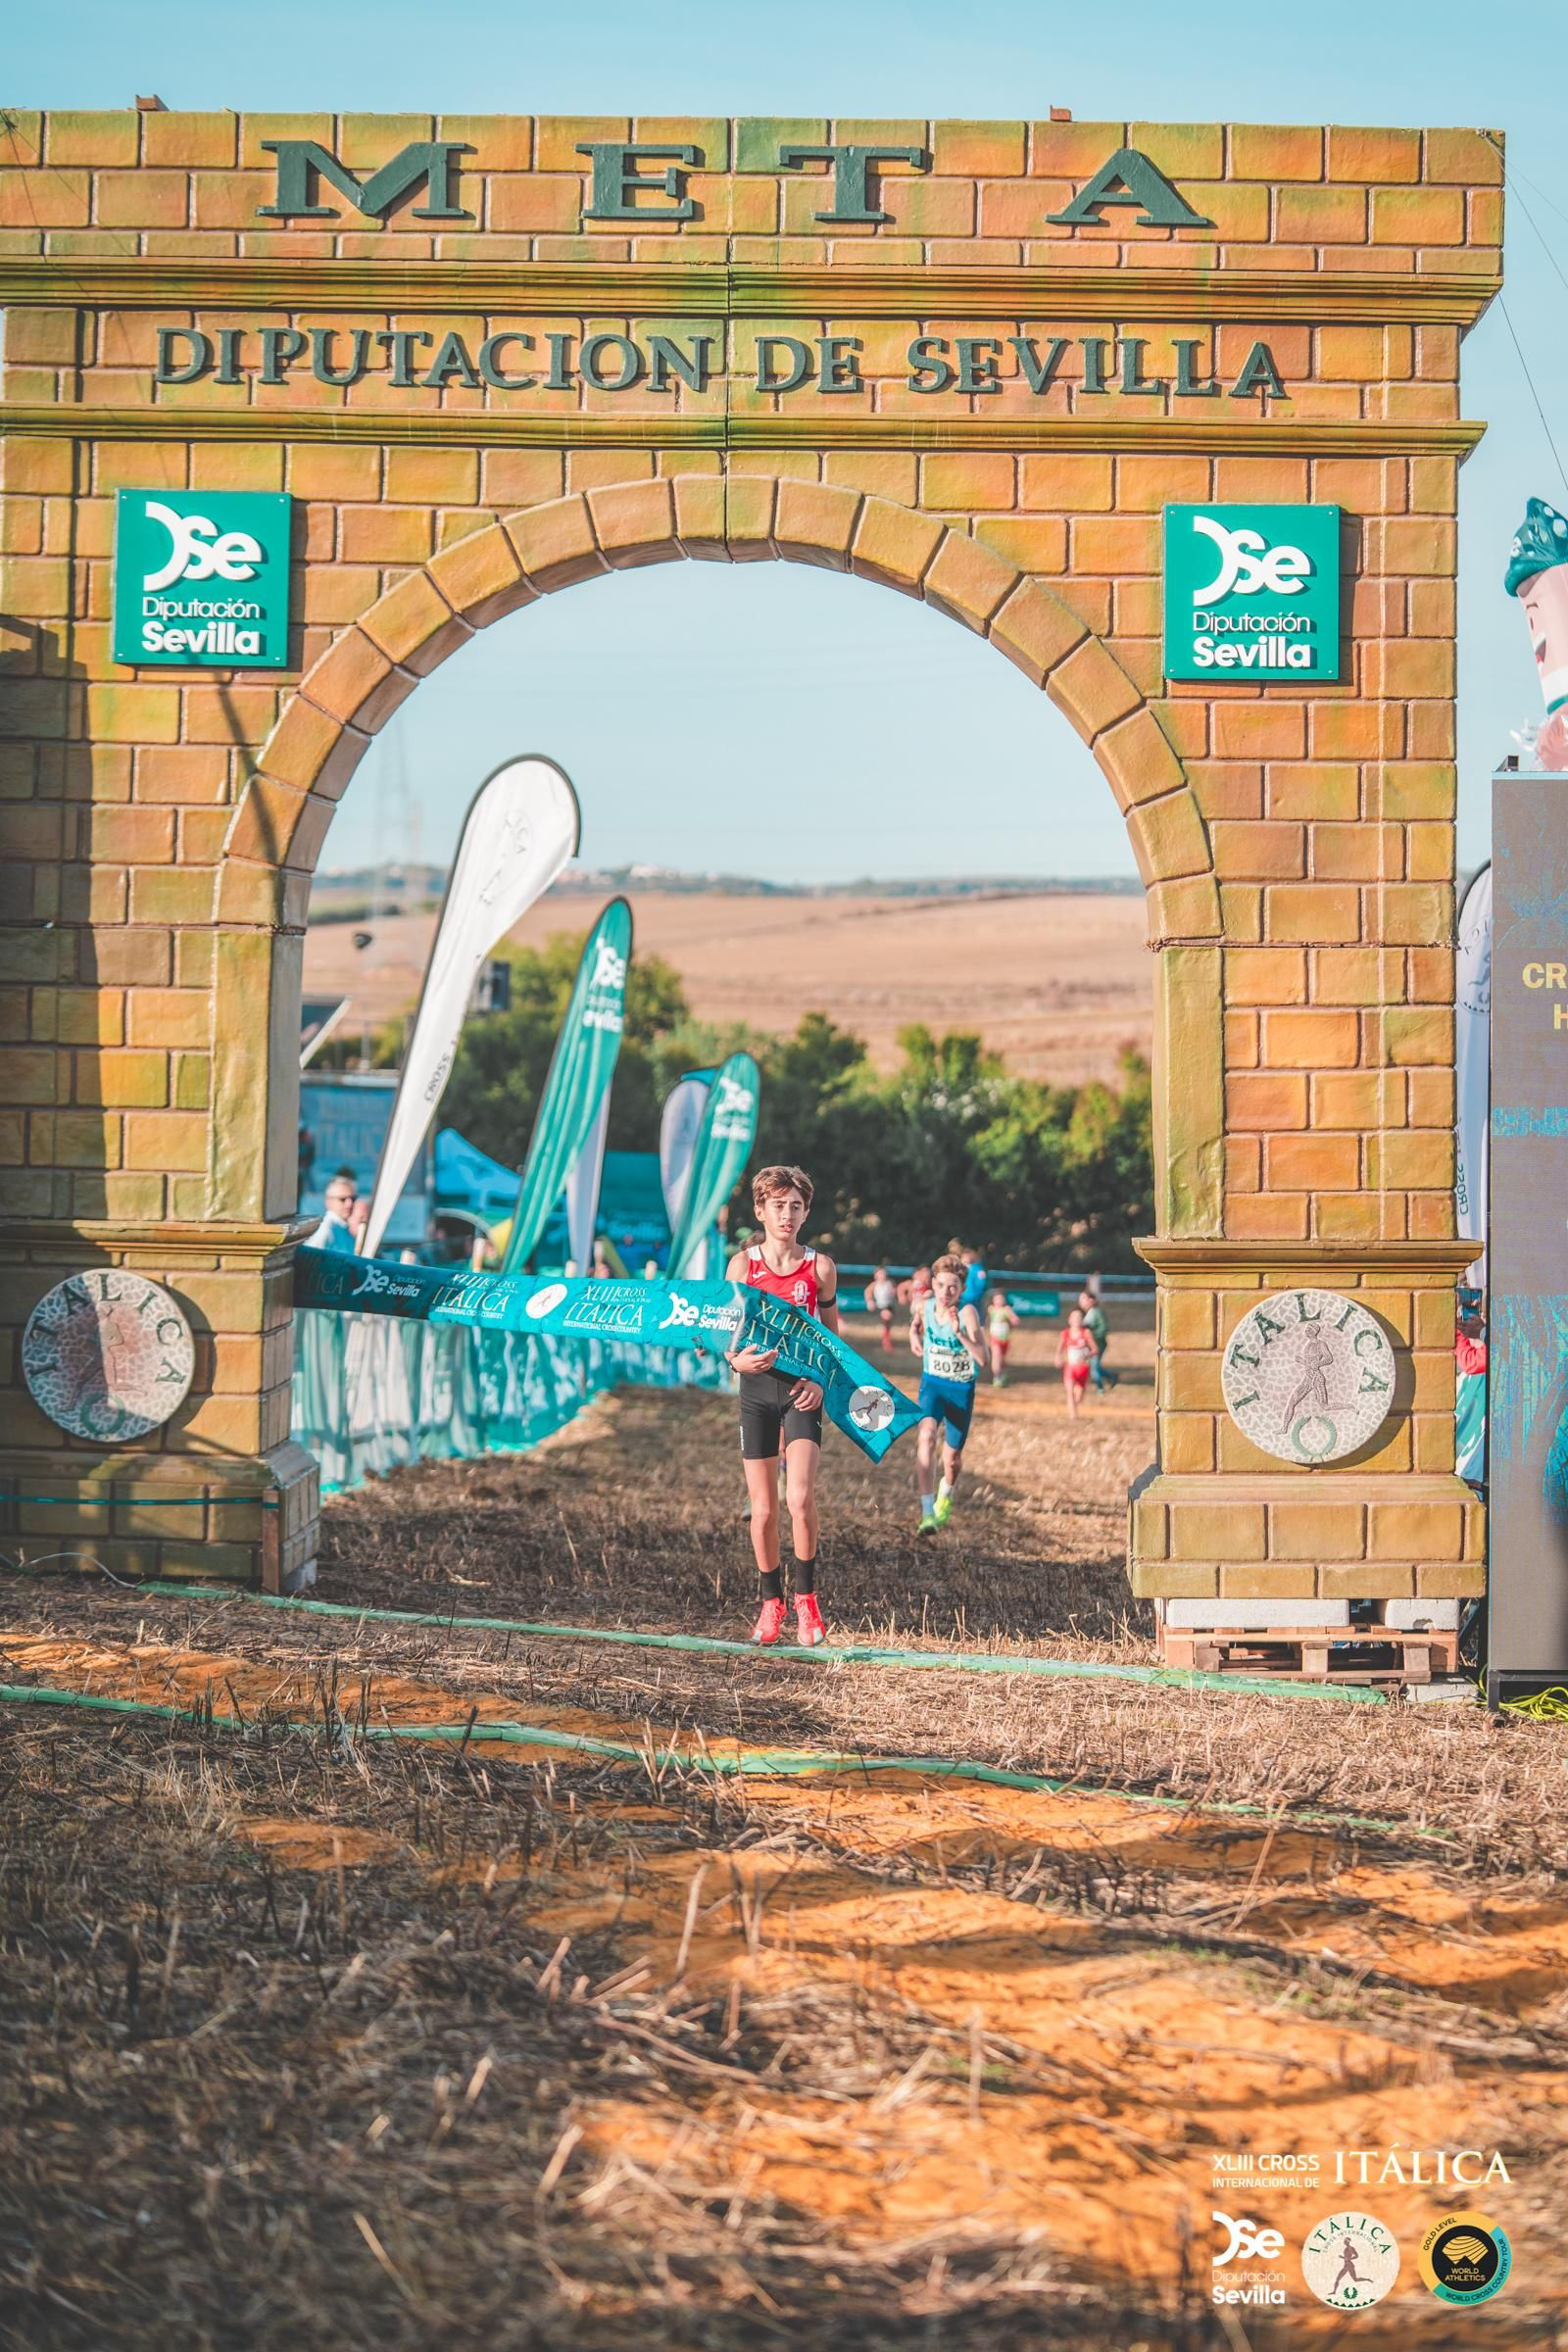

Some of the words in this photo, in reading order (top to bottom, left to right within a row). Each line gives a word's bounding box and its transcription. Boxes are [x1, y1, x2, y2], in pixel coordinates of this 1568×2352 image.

[255, 140, 1209, 226] META
[155, 327, 712, 392] DIPUTACION
[755, 336, 861, 393] DE
[906, 336, 1288, 399] SEVILLA
[142, 596, 260, 621] Diputación
[142, 620, 260, 655] Sevilla
[1193, 612, 1310, 635] Diputación
[1193, 635, 1311, 667] Sevilla
[386, 1284, 421, 1298] Sevilla
[617, 1287, 647, 1298] CROSS
[699, 1314, 738, 1332] Sevilla
[703, 1303, 741, 1318] Diputación
[756, 1300, 808, 1339] XLIII
[1230, 1294, 1390, 1411] ITALICA
